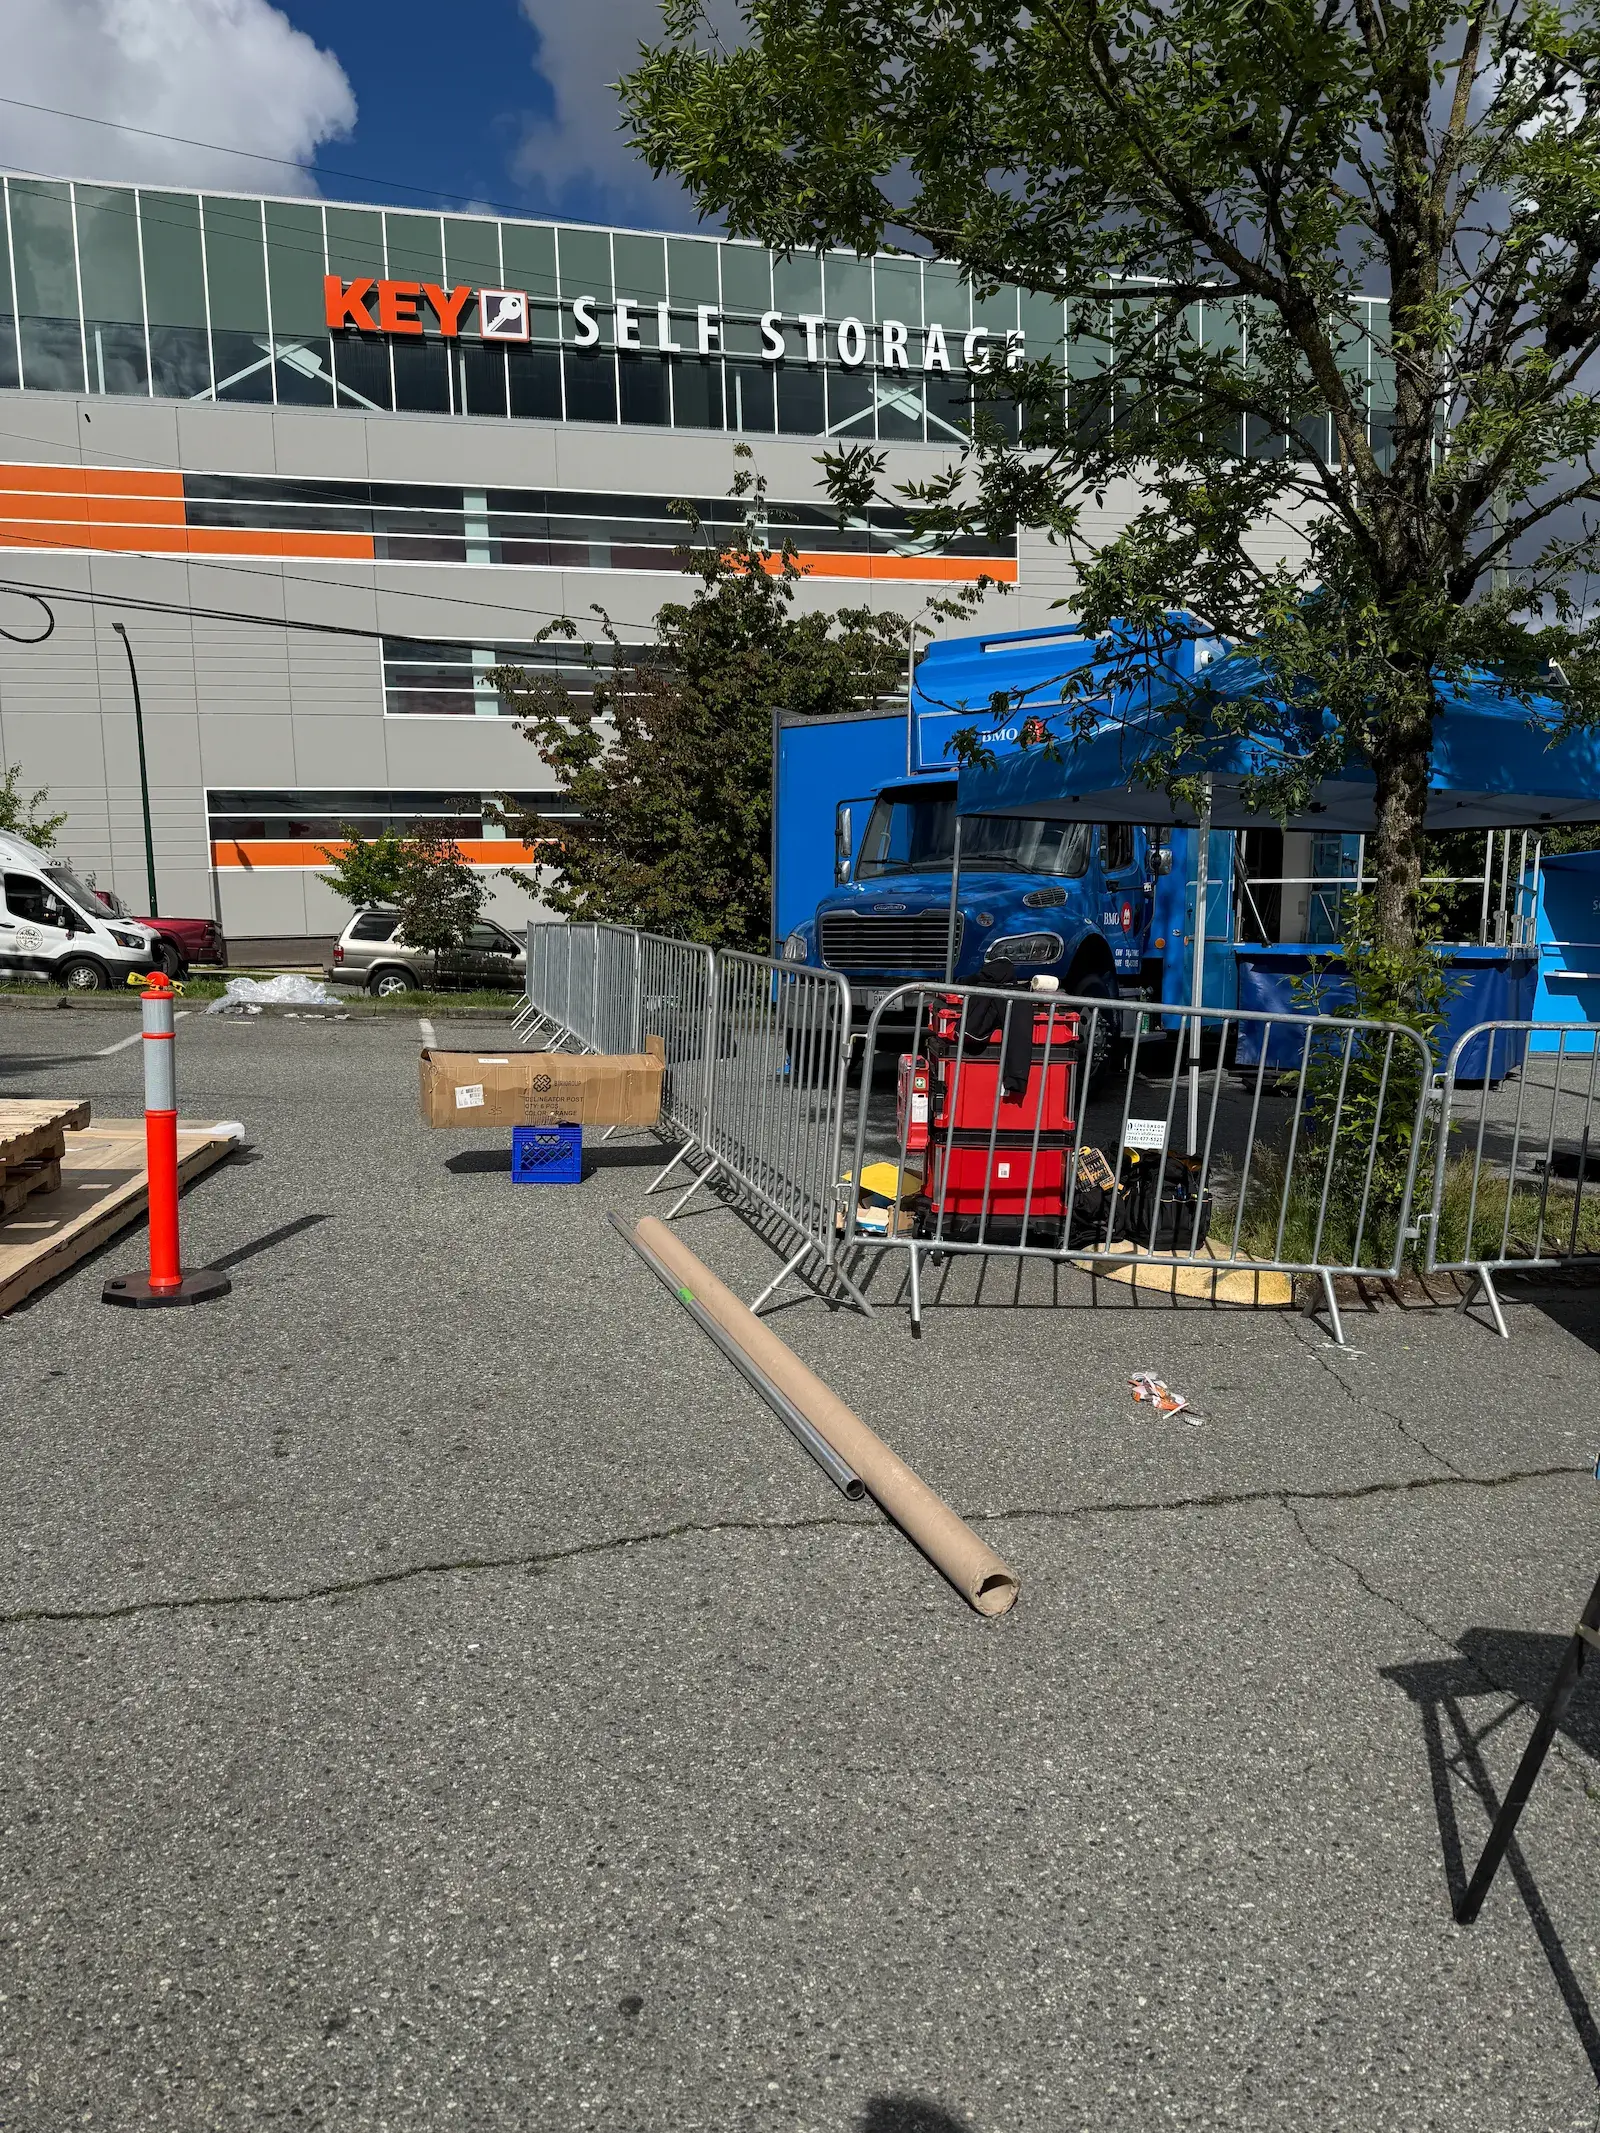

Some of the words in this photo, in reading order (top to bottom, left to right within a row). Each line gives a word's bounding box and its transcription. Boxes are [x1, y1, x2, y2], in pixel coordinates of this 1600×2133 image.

[324, 275, 472, 337] KEY
[573, 296, 719, 354] SELF
[761, 311, 1025, 374] STORAGE
[982, 728, 1019, 742] BMO
[1104, 912, 1120, 925] BMO
